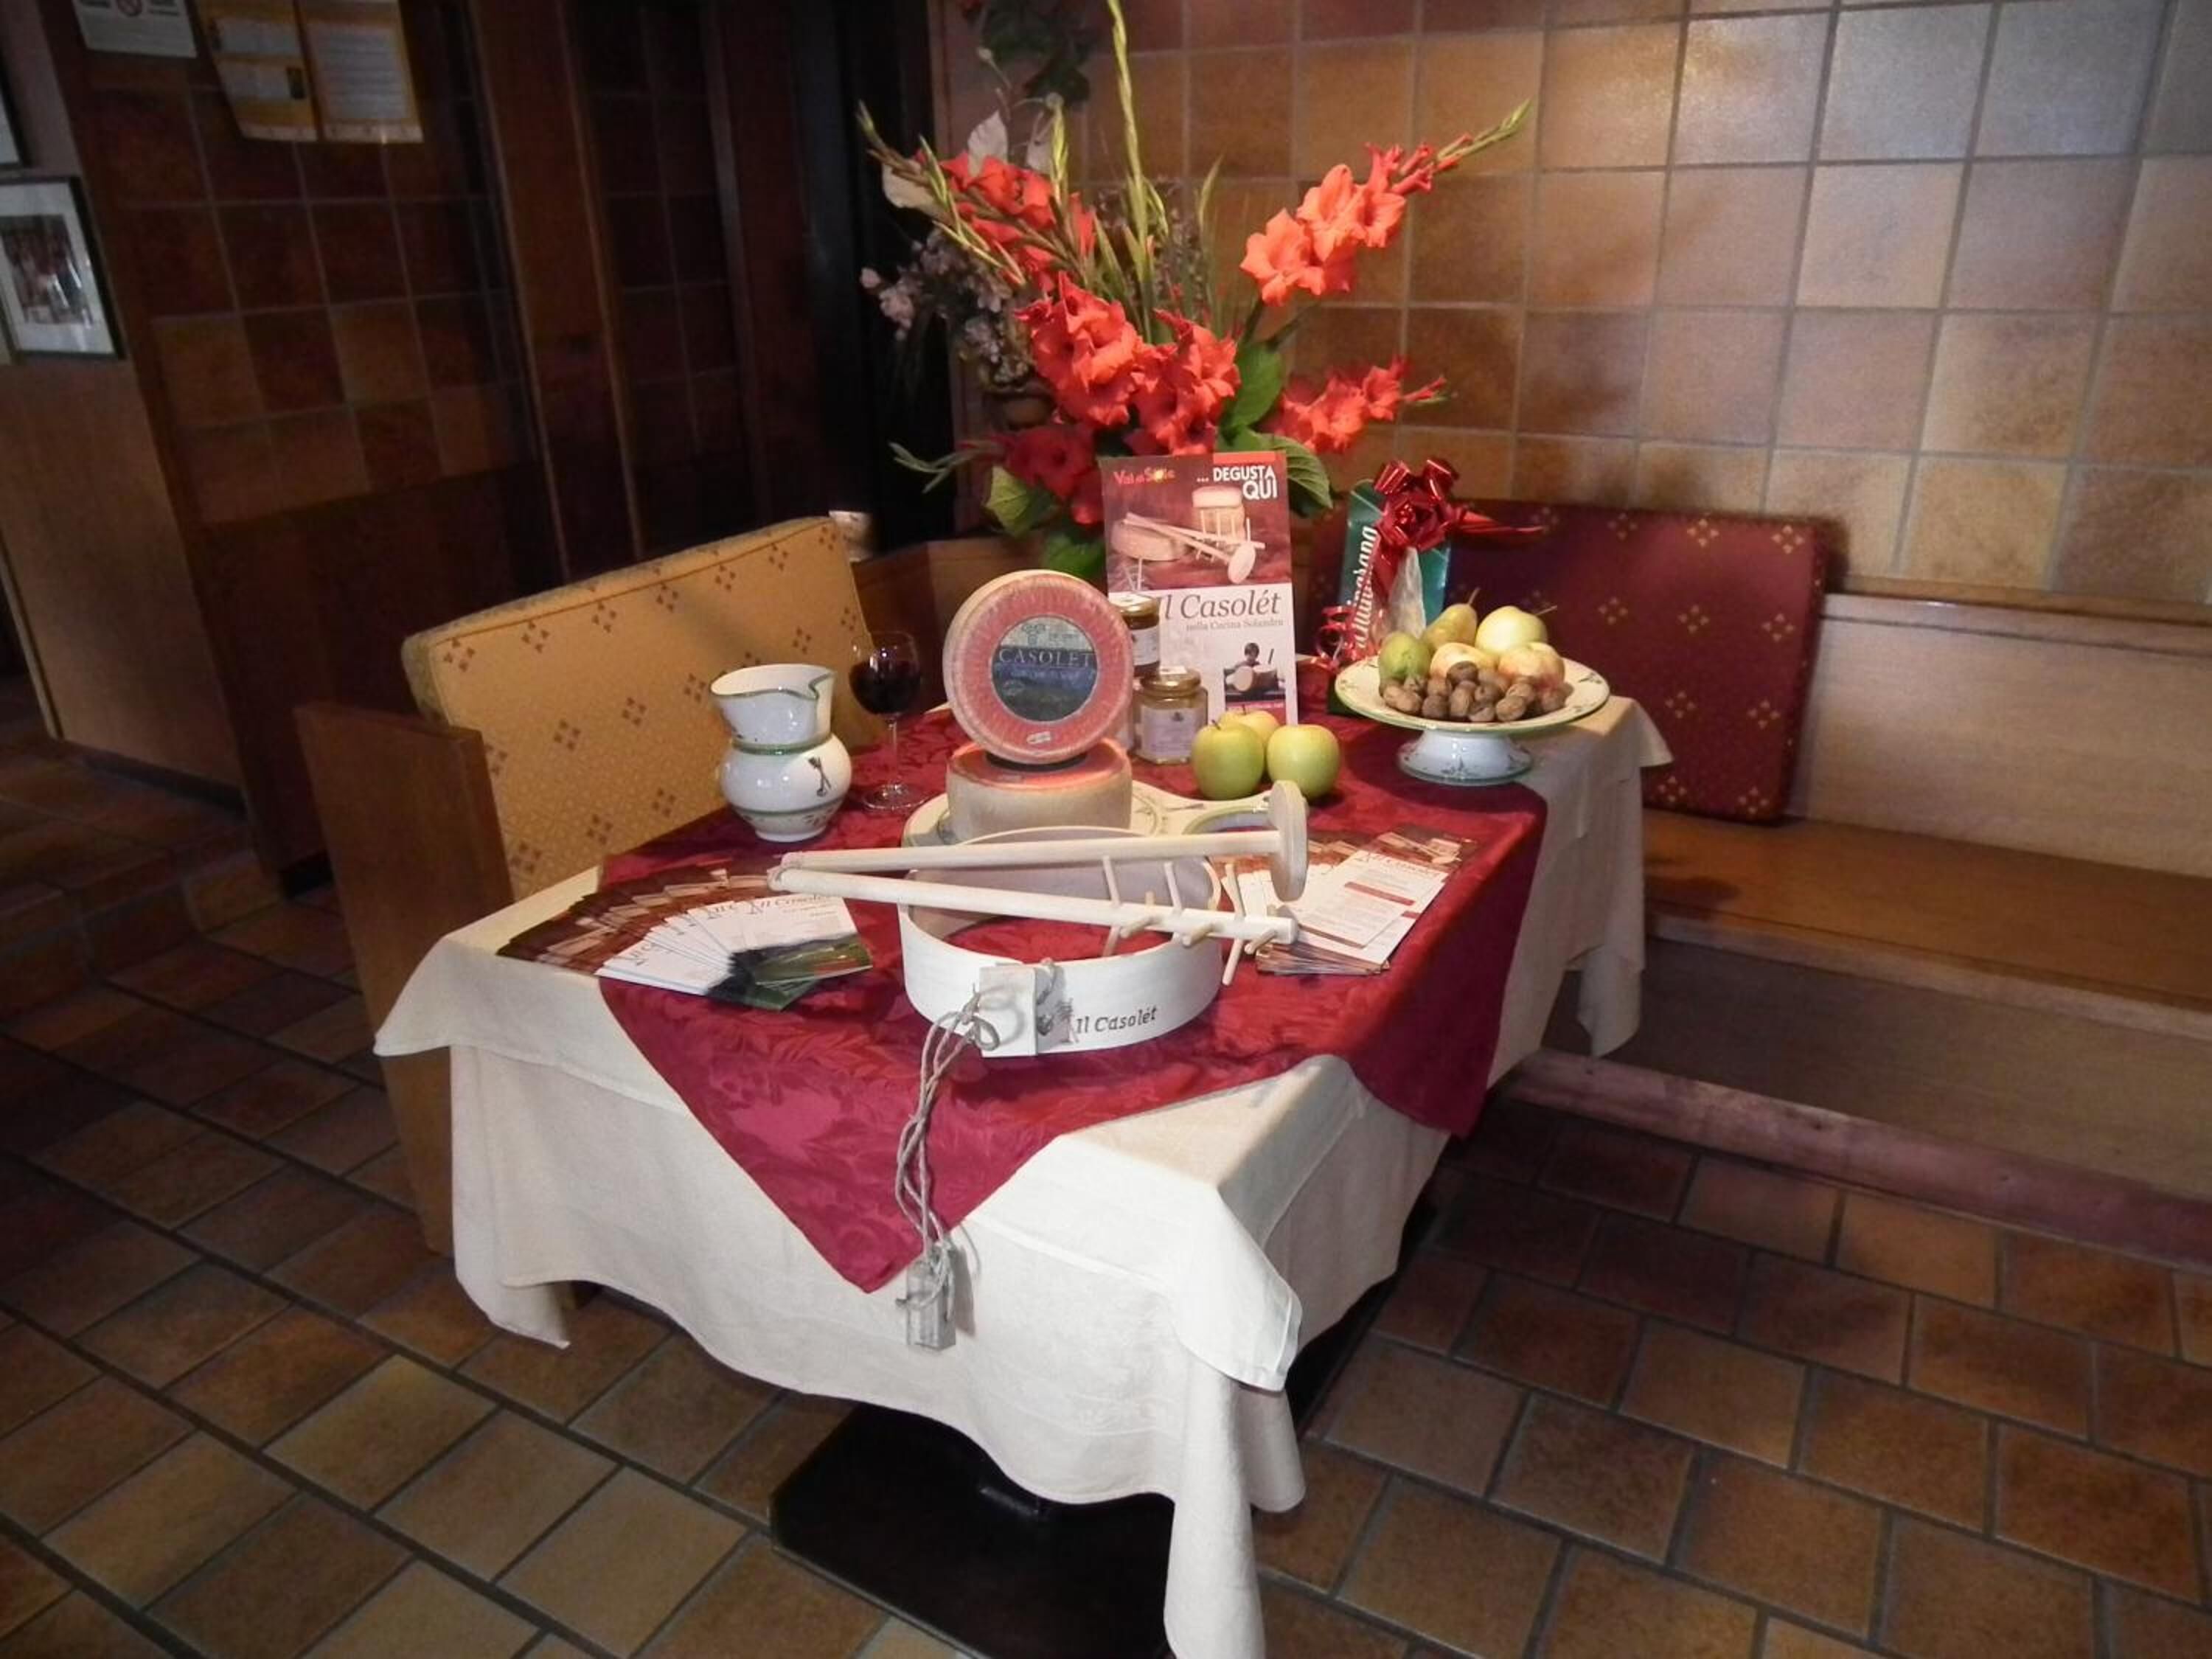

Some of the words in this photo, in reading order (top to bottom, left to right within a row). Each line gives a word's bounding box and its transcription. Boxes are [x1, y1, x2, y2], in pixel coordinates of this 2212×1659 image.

[1213, 465, 1276, 482] DEGUSTA
[1242, 479, 1279, 501] QUI
[1180, 589, 1282, 619] Casolét
[1075, 1018, 1090, 1034] Il
[1094, 1005, 1158, 1034] Casolét
